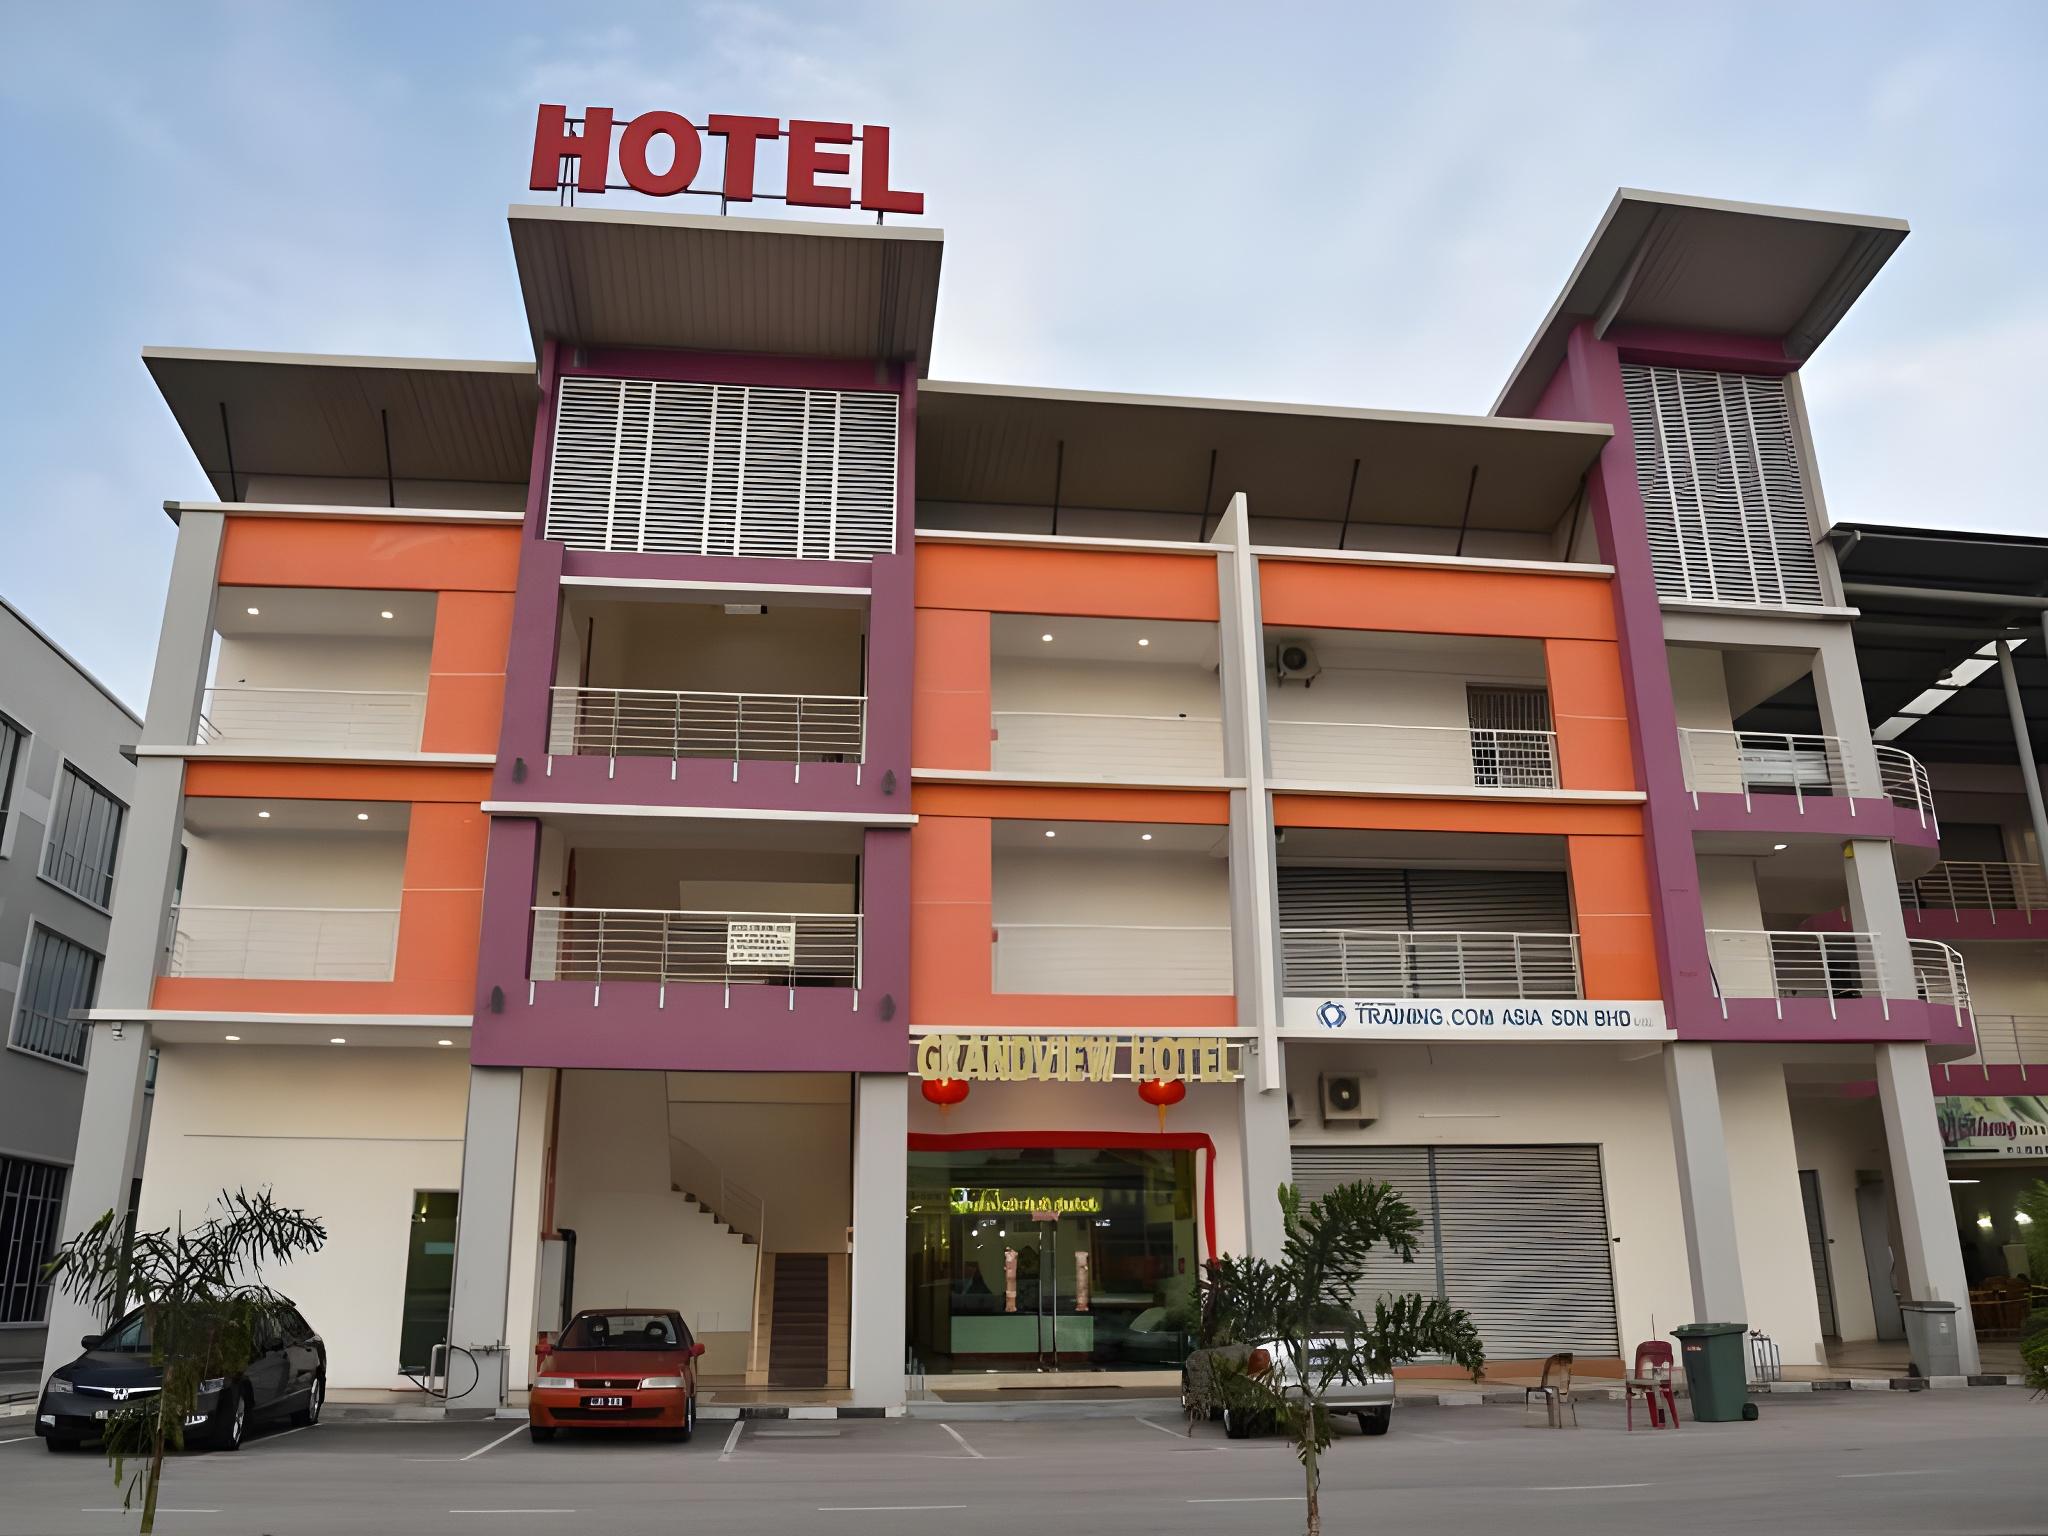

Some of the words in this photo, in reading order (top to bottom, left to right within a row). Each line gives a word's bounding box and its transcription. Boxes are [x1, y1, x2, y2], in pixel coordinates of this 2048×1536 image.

[529, 104, 924, 214] HOTEL
[1503, 1009, 1544, 1026] ASIA
[1551, 1009, 1589, 1027] SDN
[1594, 1010, 1631, 1027] BHD
[917, 1034, 1118, 1082] GRANDVIEW
[1131, 1035, 1237, 1083] HOTEL
